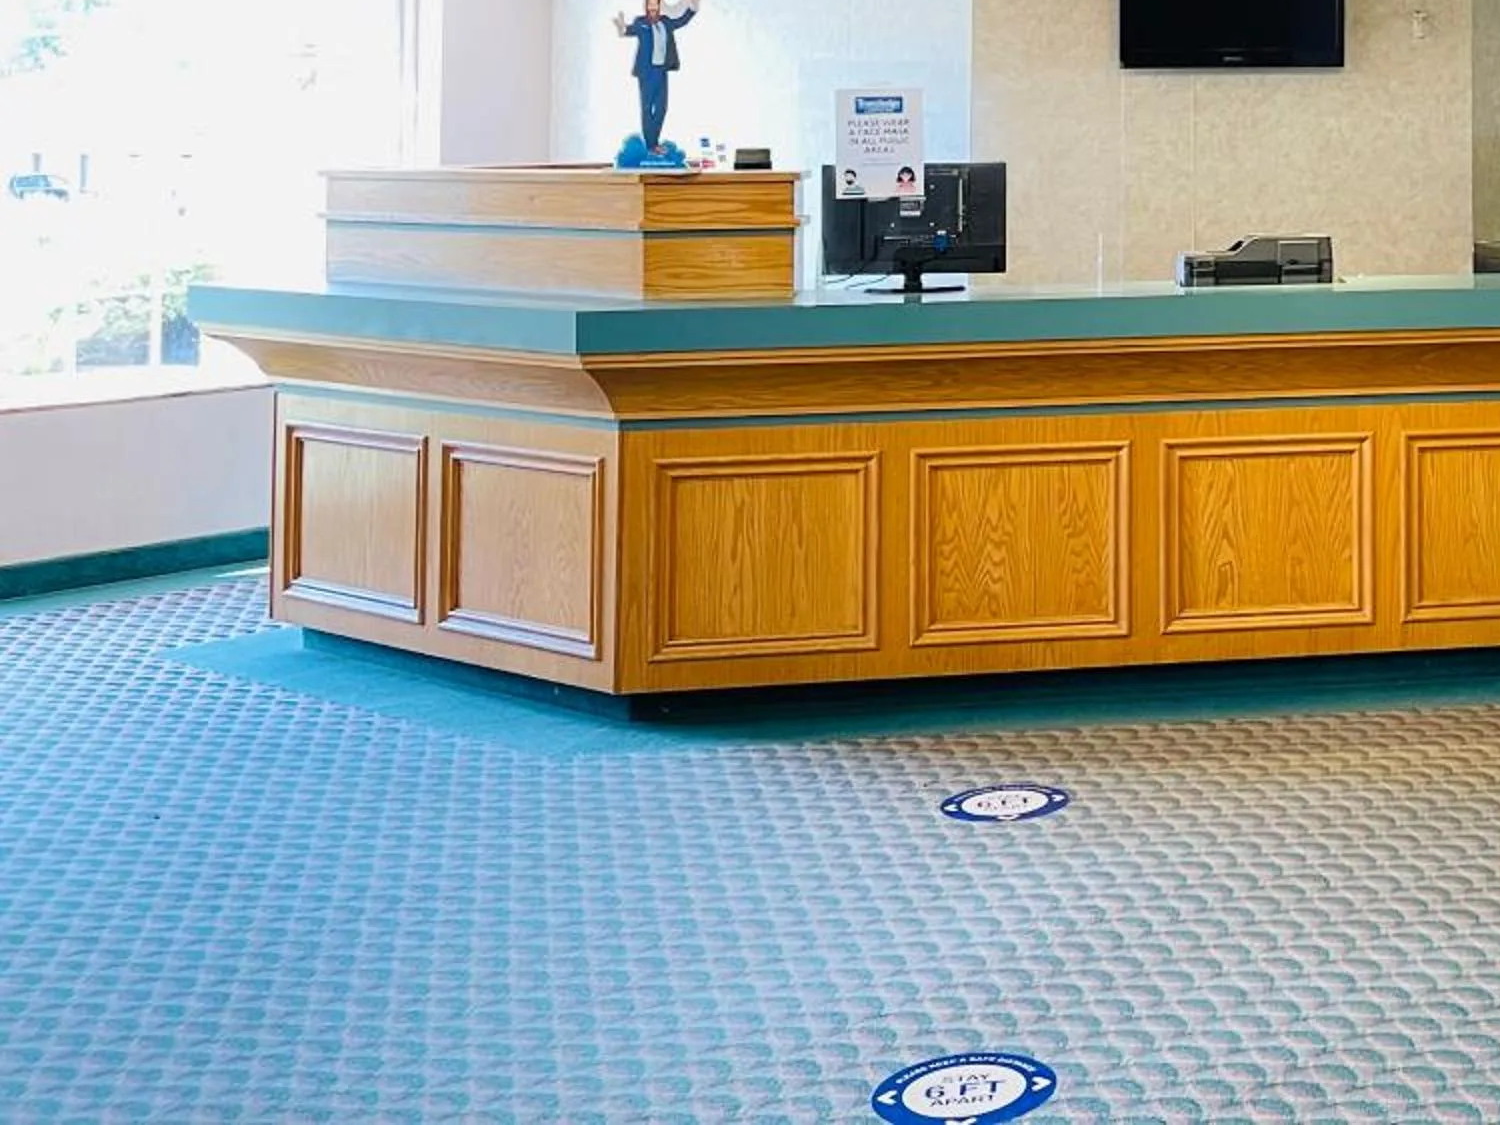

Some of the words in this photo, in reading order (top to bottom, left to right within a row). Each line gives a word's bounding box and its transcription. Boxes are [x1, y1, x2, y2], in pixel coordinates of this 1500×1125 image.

[883, 127, 910, 135] MASK
[925, 1085, 945, 1100] 6
[959, 1079, 1006, 1096] FT
[930, 1094, 994, 1107] APART
